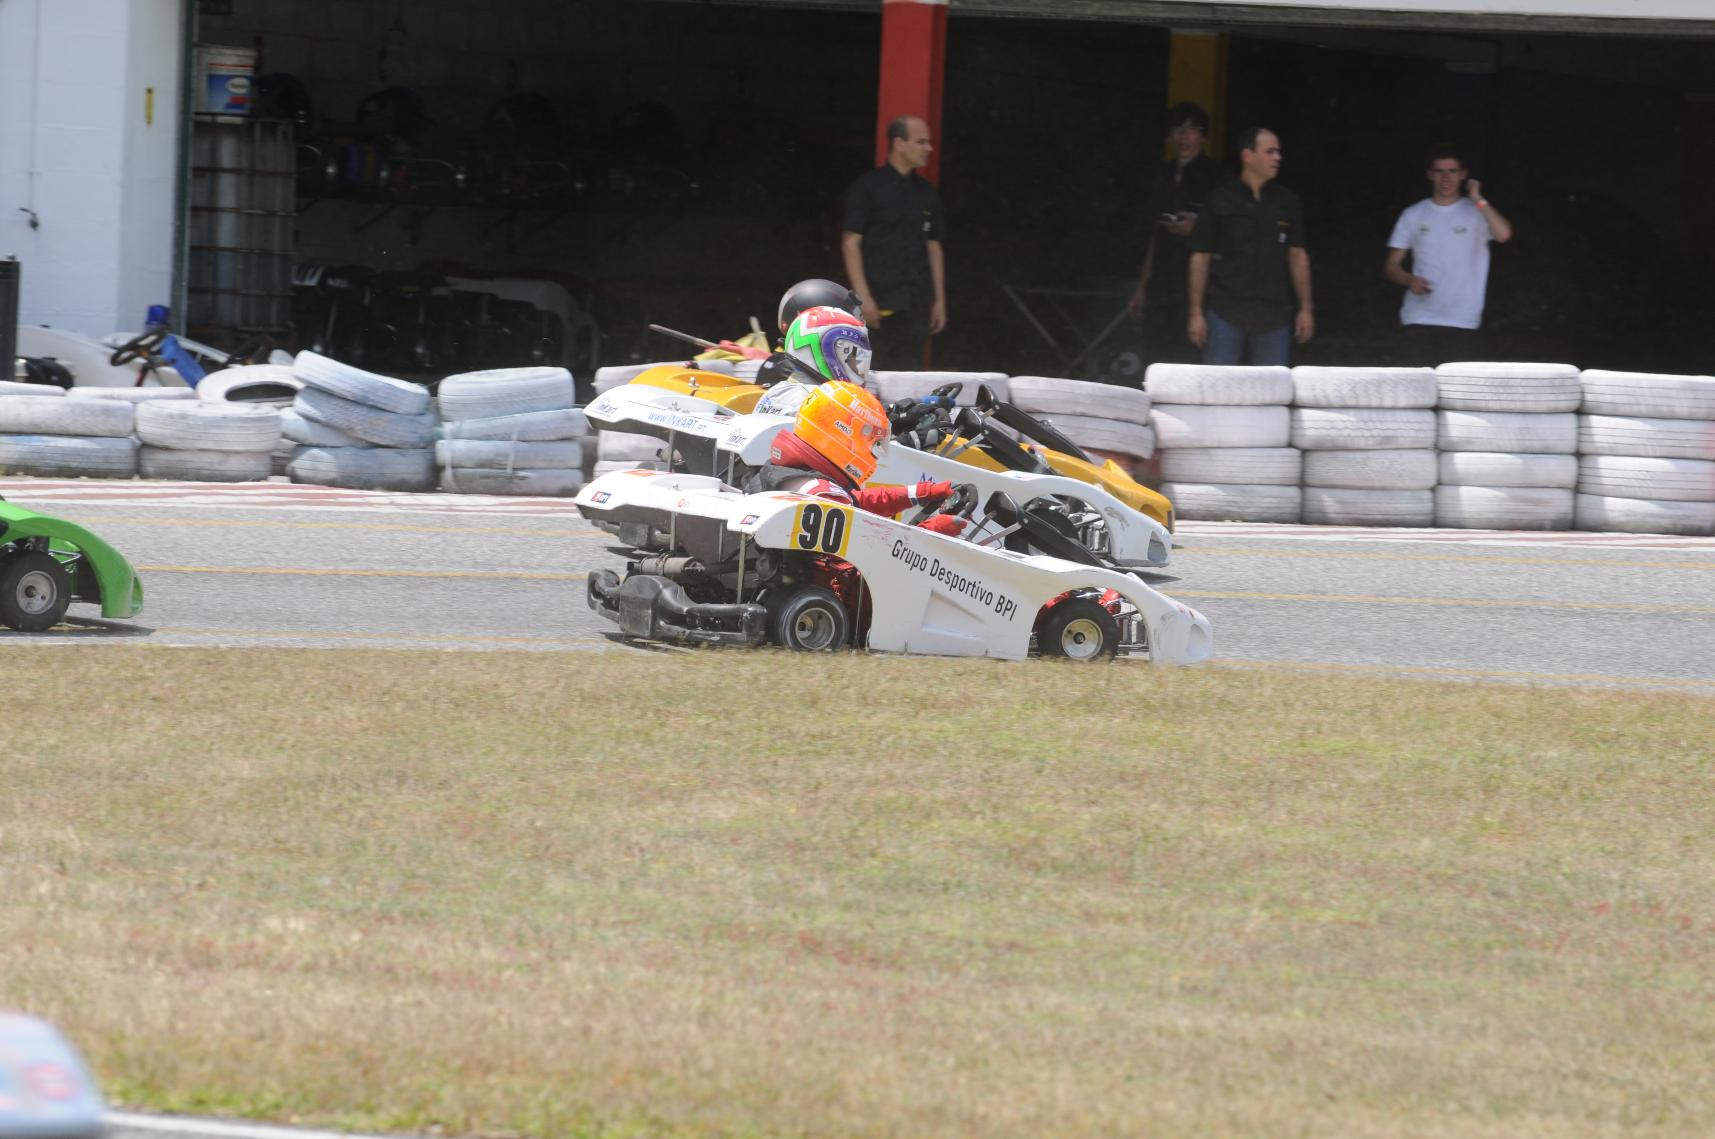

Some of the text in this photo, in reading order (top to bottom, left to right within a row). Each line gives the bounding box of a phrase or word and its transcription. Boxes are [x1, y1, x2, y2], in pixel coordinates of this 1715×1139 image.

[798, 503, 846, 554] 90
[891, 539, 1018, 621] Grupo Desportivo BPI
